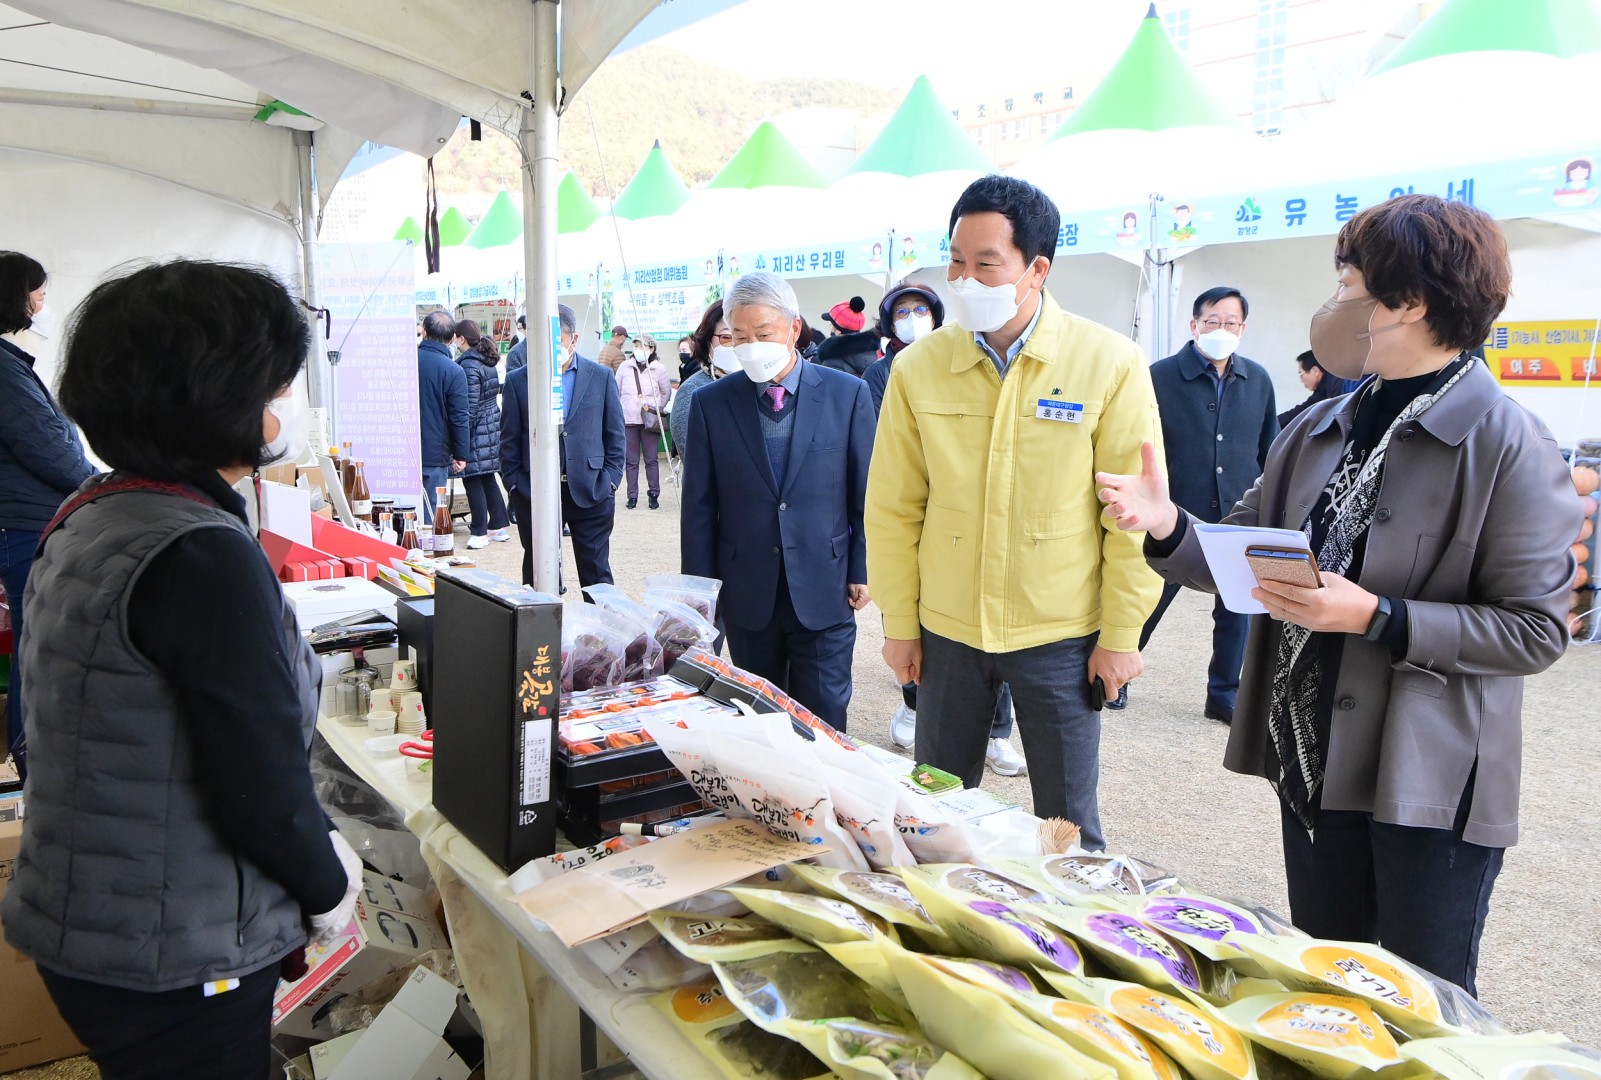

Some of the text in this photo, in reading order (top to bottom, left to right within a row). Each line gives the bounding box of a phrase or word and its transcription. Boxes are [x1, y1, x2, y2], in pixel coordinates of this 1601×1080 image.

[772, 250, 845, 273] 지리산 우리밀
[1043, 408, 1076, 421] 홍순헌
[533, 645, 551, 677] 대봉
[690, 769, 729, 792] 대봉감
[751, 798, 789, 827] 대봉감
